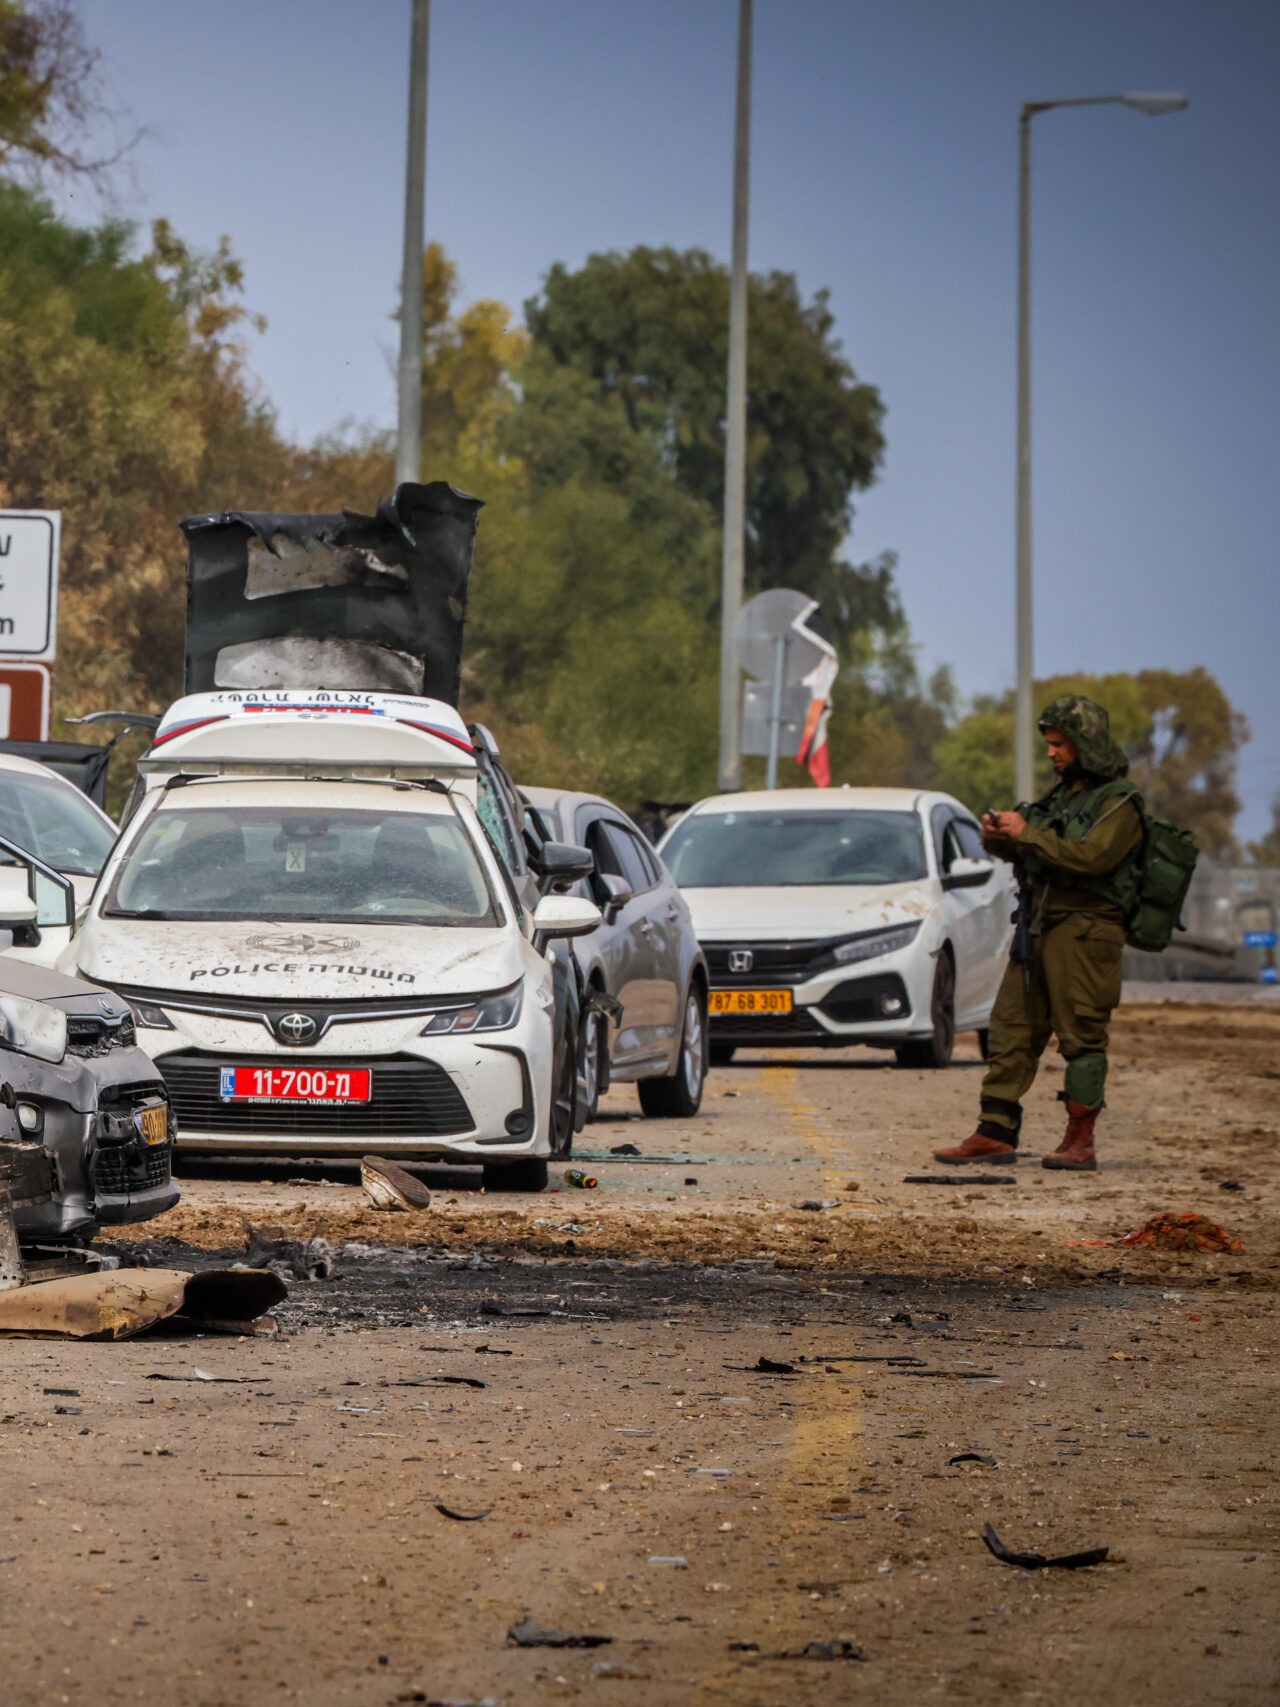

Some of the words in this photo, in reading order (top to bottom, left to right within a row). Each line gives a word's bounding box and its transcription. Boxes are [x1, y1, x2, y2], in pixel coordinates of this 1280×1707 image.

[308, 692, 375, 706] ישראל
[189, 963, 299, 982] POLICE
[308, 963, 416, 984] משטרה
[223, 1076, 233, 1089] IL
